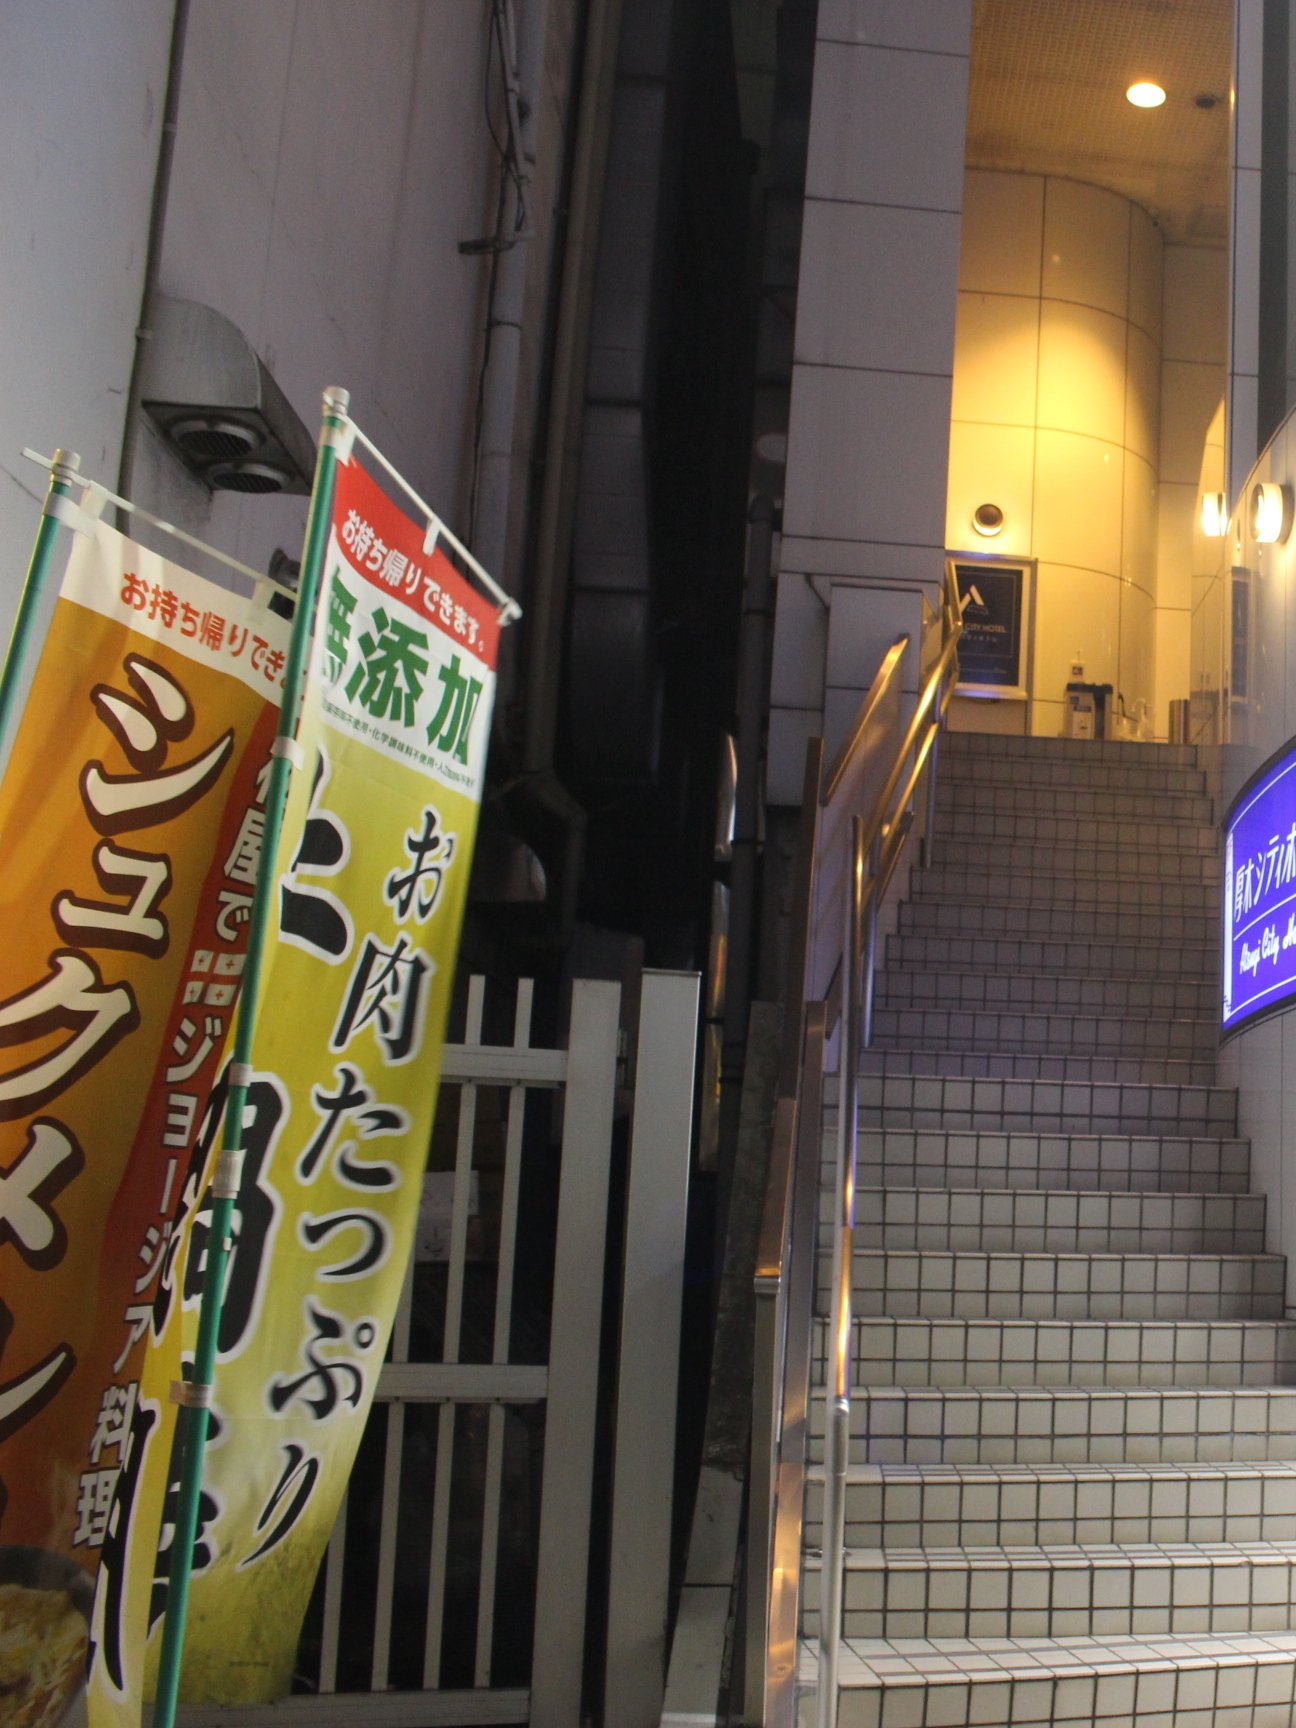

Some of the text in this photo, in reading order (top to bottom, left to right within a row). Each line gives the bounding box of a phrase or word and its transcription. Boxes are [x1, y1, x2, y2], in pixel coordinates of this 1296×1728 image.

[120, 572, 289, 690] お持ち帰りでき
[341, 508, 485, 653] お持ち帰りできます。
[1239, 934, 1261, 976] Atsugi
[1262, 926, 1280, 966] City
[241, 808, 456, 1569] お肉たっぷり
